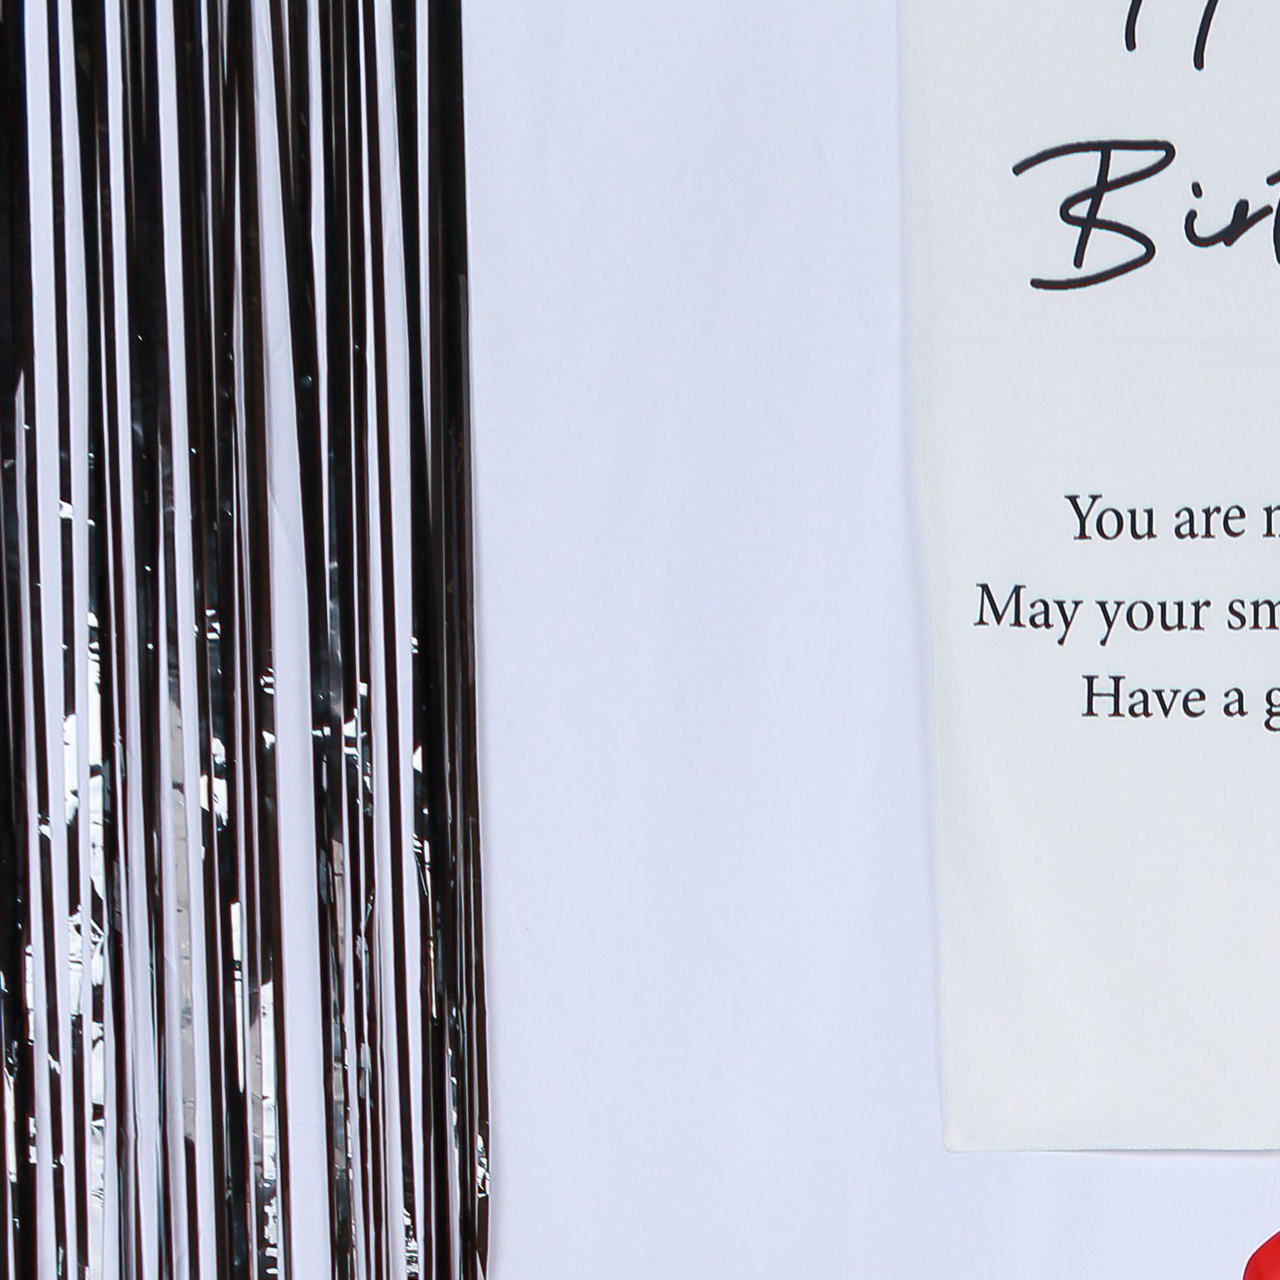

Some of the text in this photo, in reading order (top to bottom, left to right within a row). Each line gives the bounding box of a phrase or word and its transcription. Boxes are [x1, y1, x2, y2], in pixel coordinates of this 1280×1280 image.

[1063, 494, 1158, 541] You
[1174, 504, 1246, 540] are
[973, 583, 1084, 646] May
[1095, 599, 1212, 647] your
[1081, 674, 1206, 719] Have
[1223, 687, 1249, 718] a
